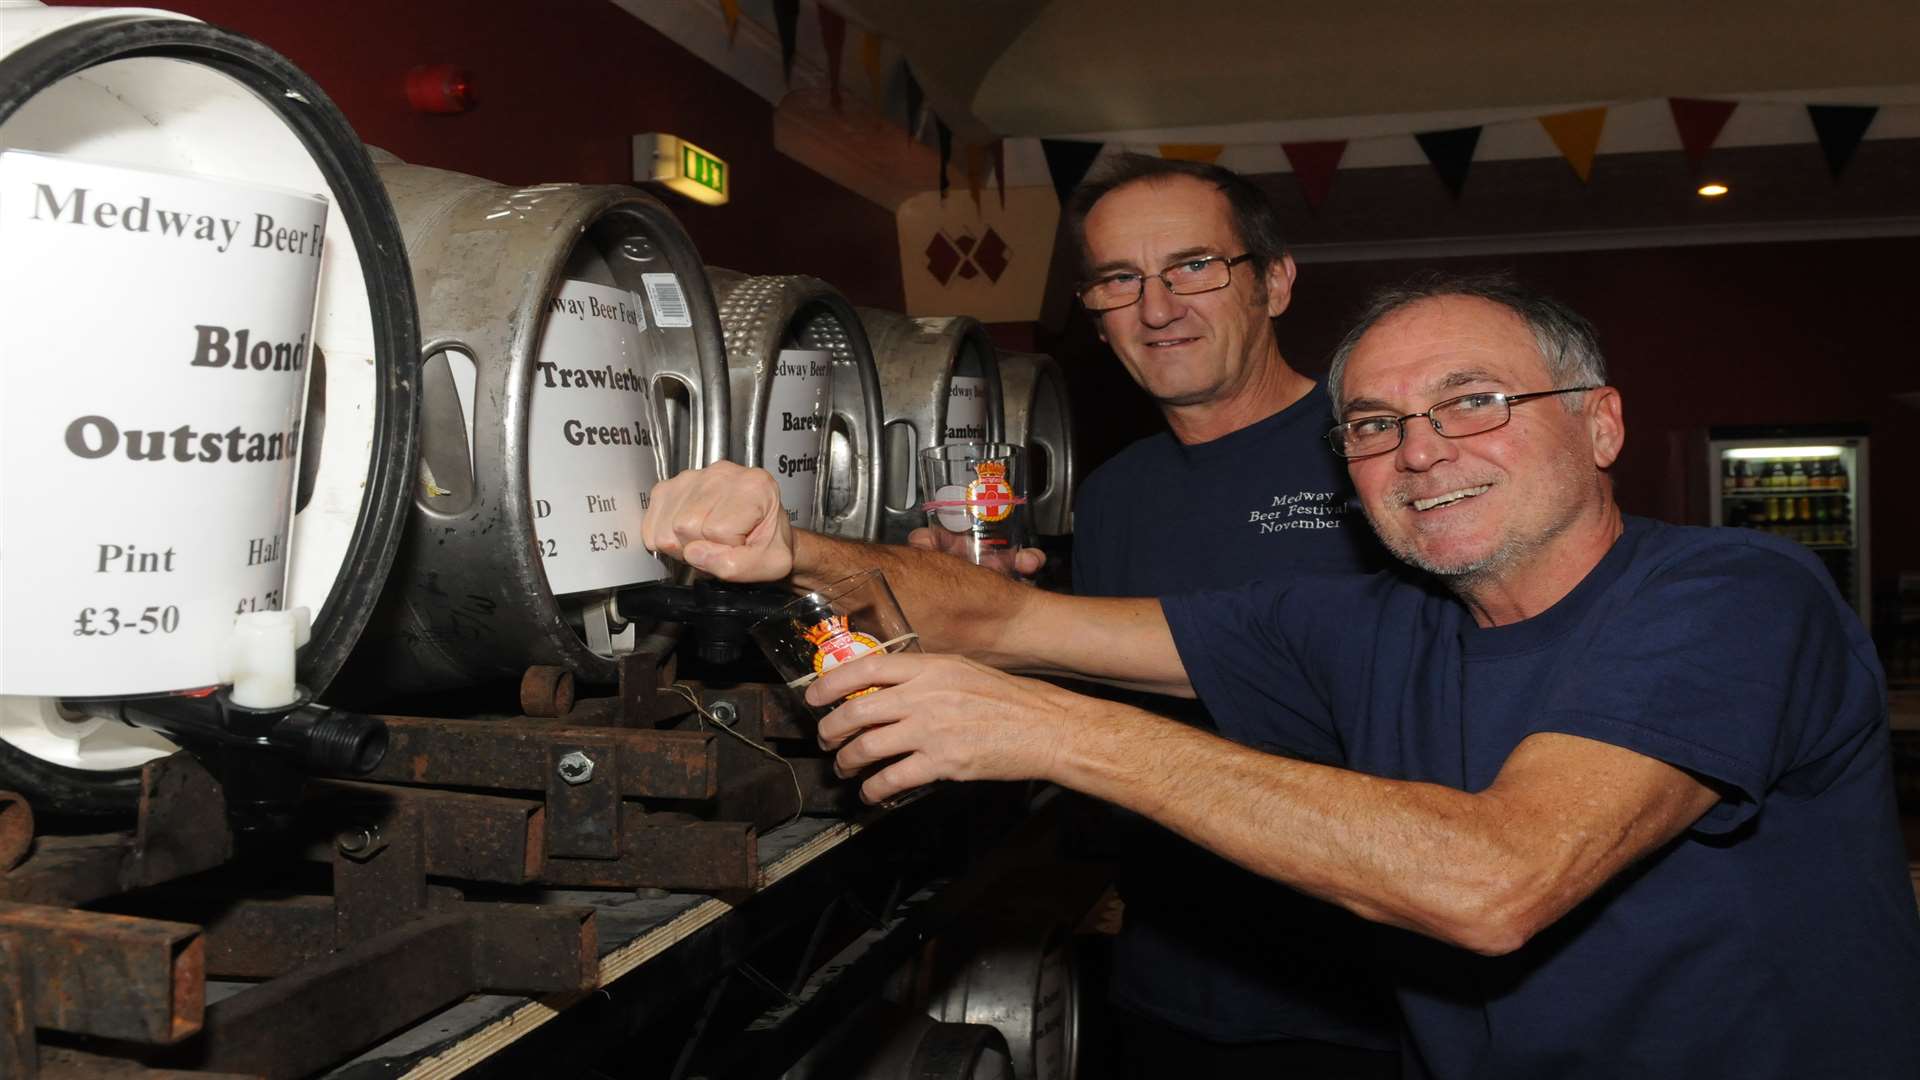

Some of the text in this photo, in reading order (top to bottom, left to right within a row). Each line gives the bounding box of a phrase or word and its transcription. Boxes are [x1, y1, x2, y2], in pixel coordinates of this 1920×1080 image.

[31, 183, 240, 252] Medway
[251, 213, 308, 255] Beer
[588, 296, 617, 320] Beer
[563, 420, 631, 446] Green
[586, 495, 616, 513] Pint
[1272, 491, 1334, 506] Medway
[1248, 502, 1350, 522] Beer Festival
[1260, 518, 1340, 534] November
[589, 531, 627, 552] £3-50
[95, 544, 176, 573] Pint
[73, 605, 180, 636] £3-50
